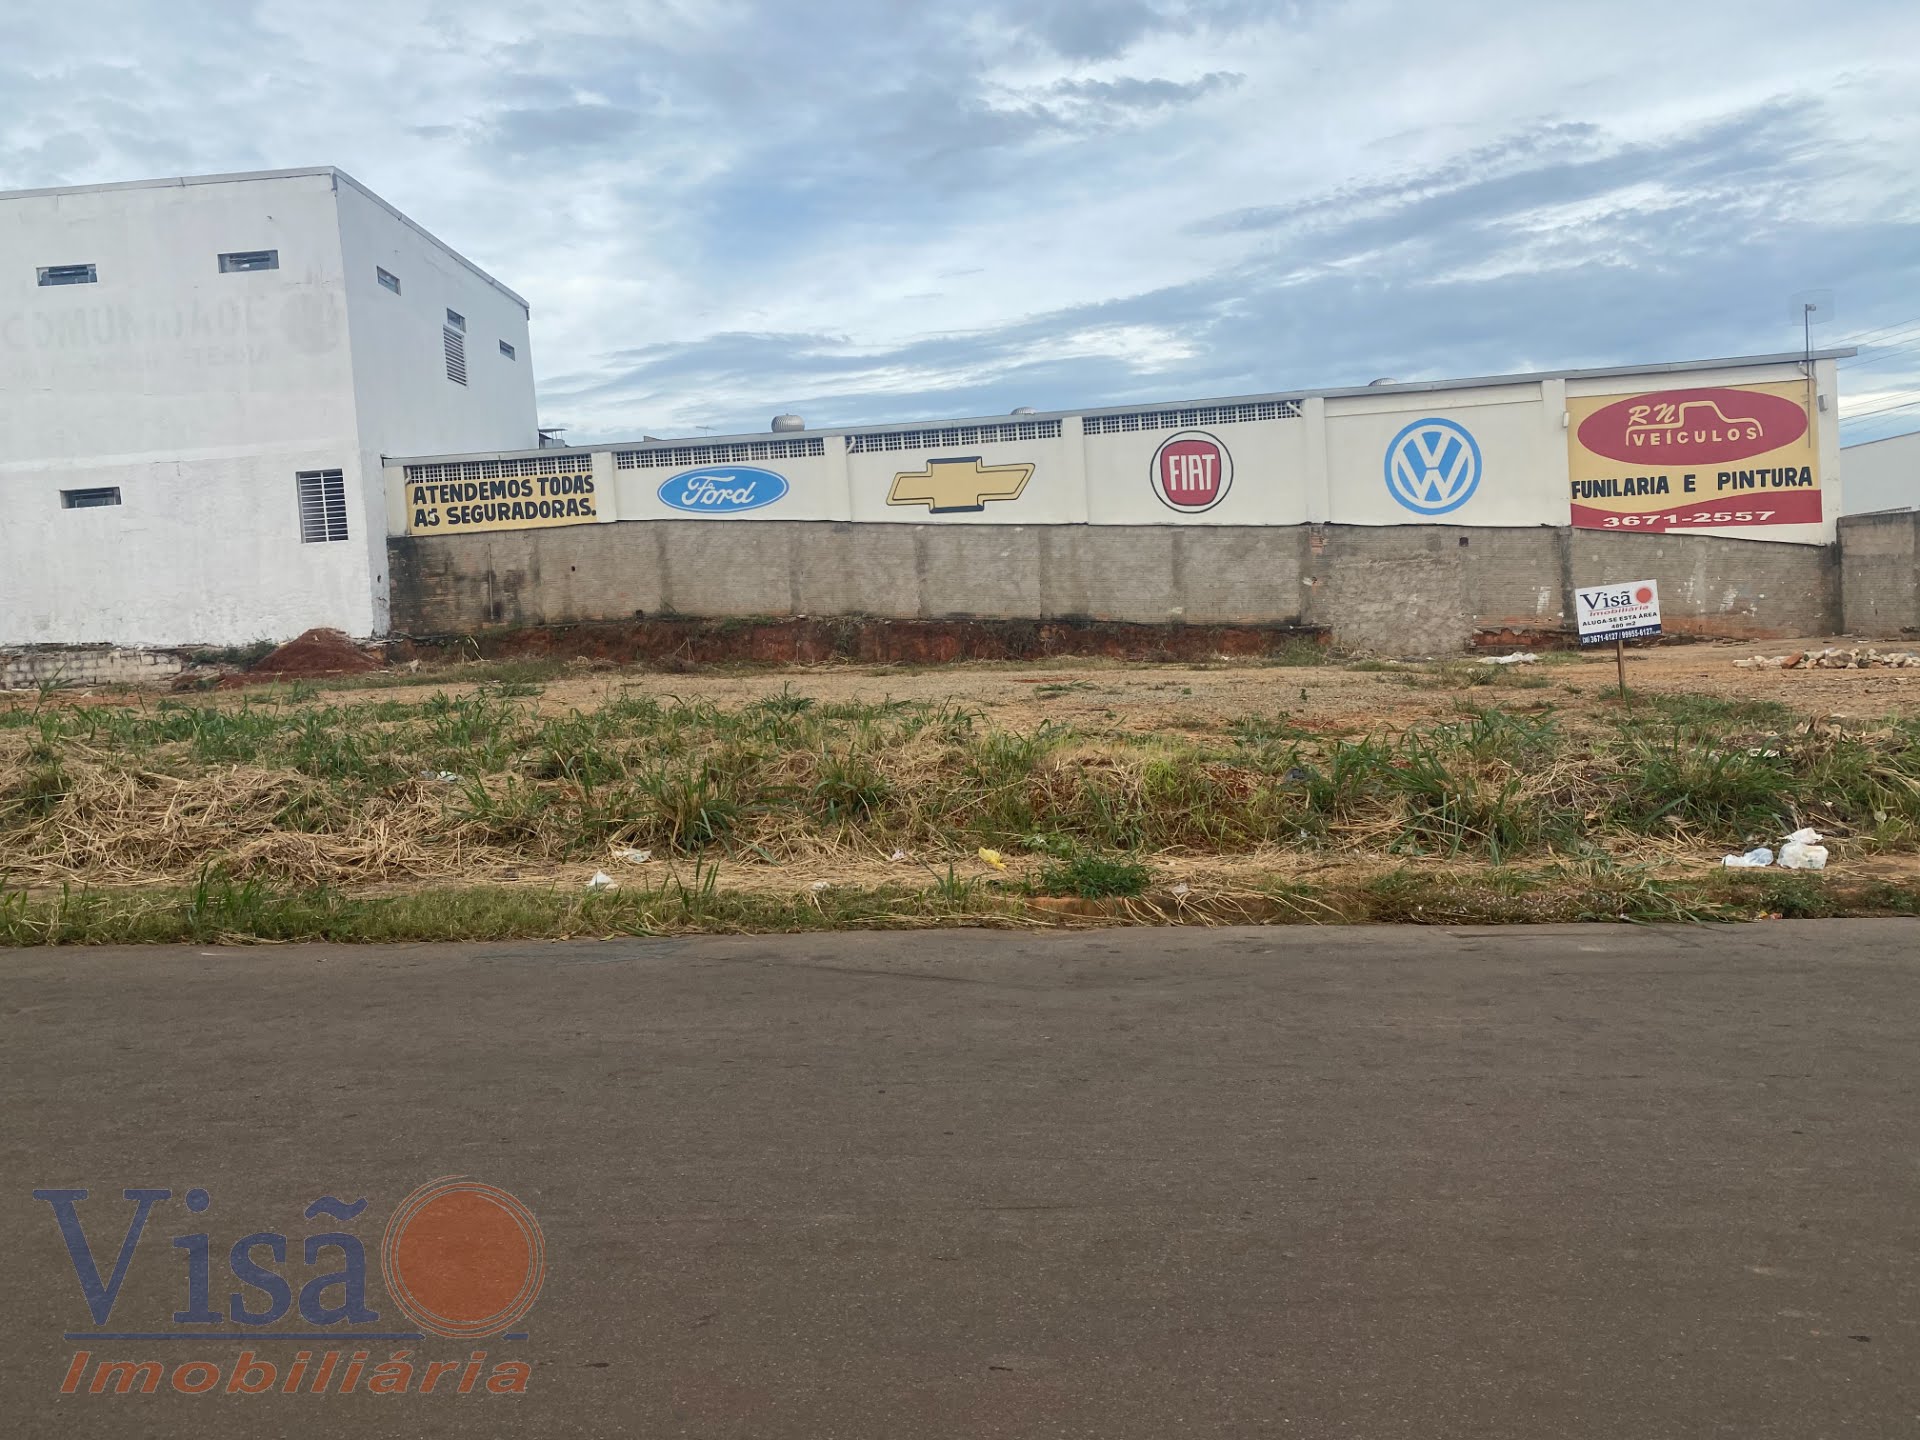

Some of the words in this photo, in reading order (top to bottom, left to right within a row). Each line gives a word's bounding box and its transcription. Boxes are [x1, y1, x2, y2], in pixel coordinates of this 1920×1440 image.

[1632, 426, 1758, 447] VEÍCULOS
[1168, 453, 1216, 492] FIAT
[1571, 475, 1670, 500] FUNILARIA
[1683, 474, 1696, 493] E
[1717, 466, 1813, 491] PINTURA
[413, 478, 534, 505] ATENDEMOS
[536, 474, 595, 497] TODAS
[680, 474, 758, 506] Ford
[413, 507, 441, 528] AS
[446, 497, 597, 526] SEGURADORAS.
[1602, 510, 1776, 528] 3671-2557
[1619, 614, 1637, 622] ESTA
[1638, 611, 1658, 619] ÁREA
